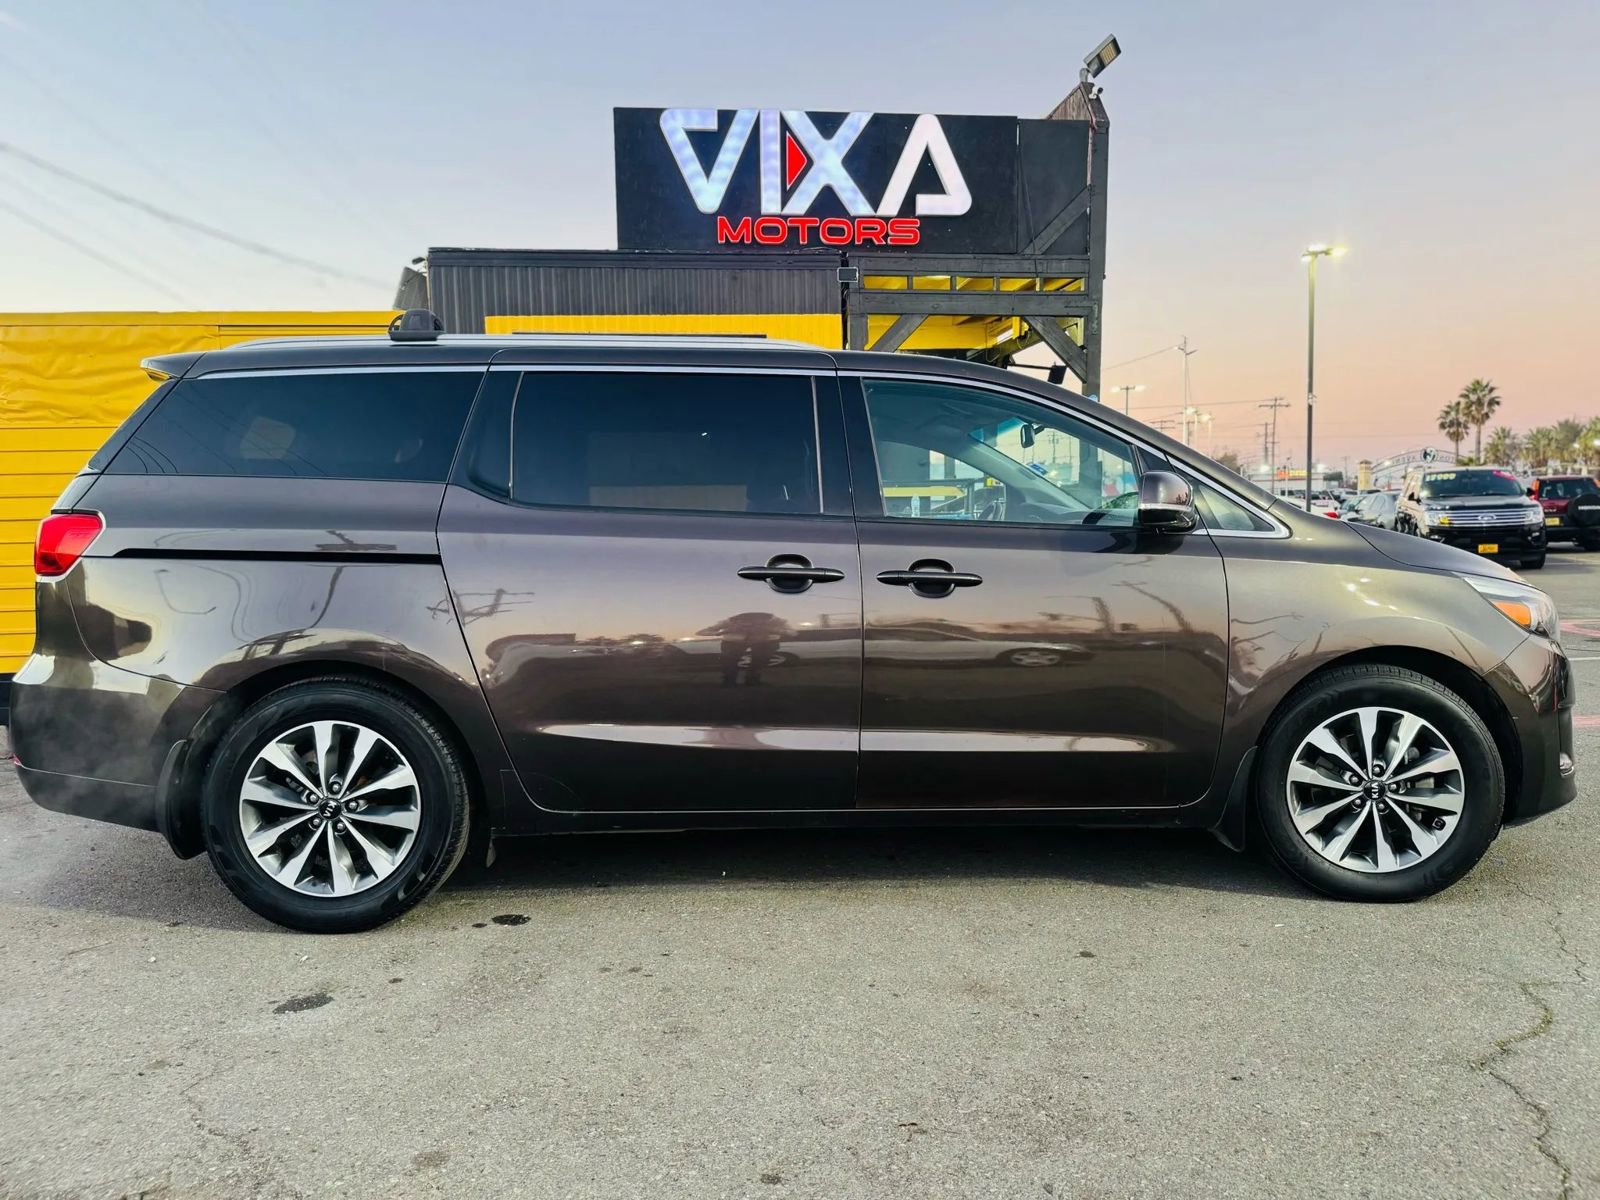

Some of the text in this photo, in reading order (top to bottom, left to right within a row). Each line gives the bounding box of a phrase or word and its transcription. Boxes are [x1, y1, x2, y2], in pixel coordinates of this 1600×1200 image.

[659, 108, 972, 217] VIXA
[717, 216, 920, 245] MOTORS
[1371, 782, 1379, 799] KIA
[323, 800, 337, 817] KIA
